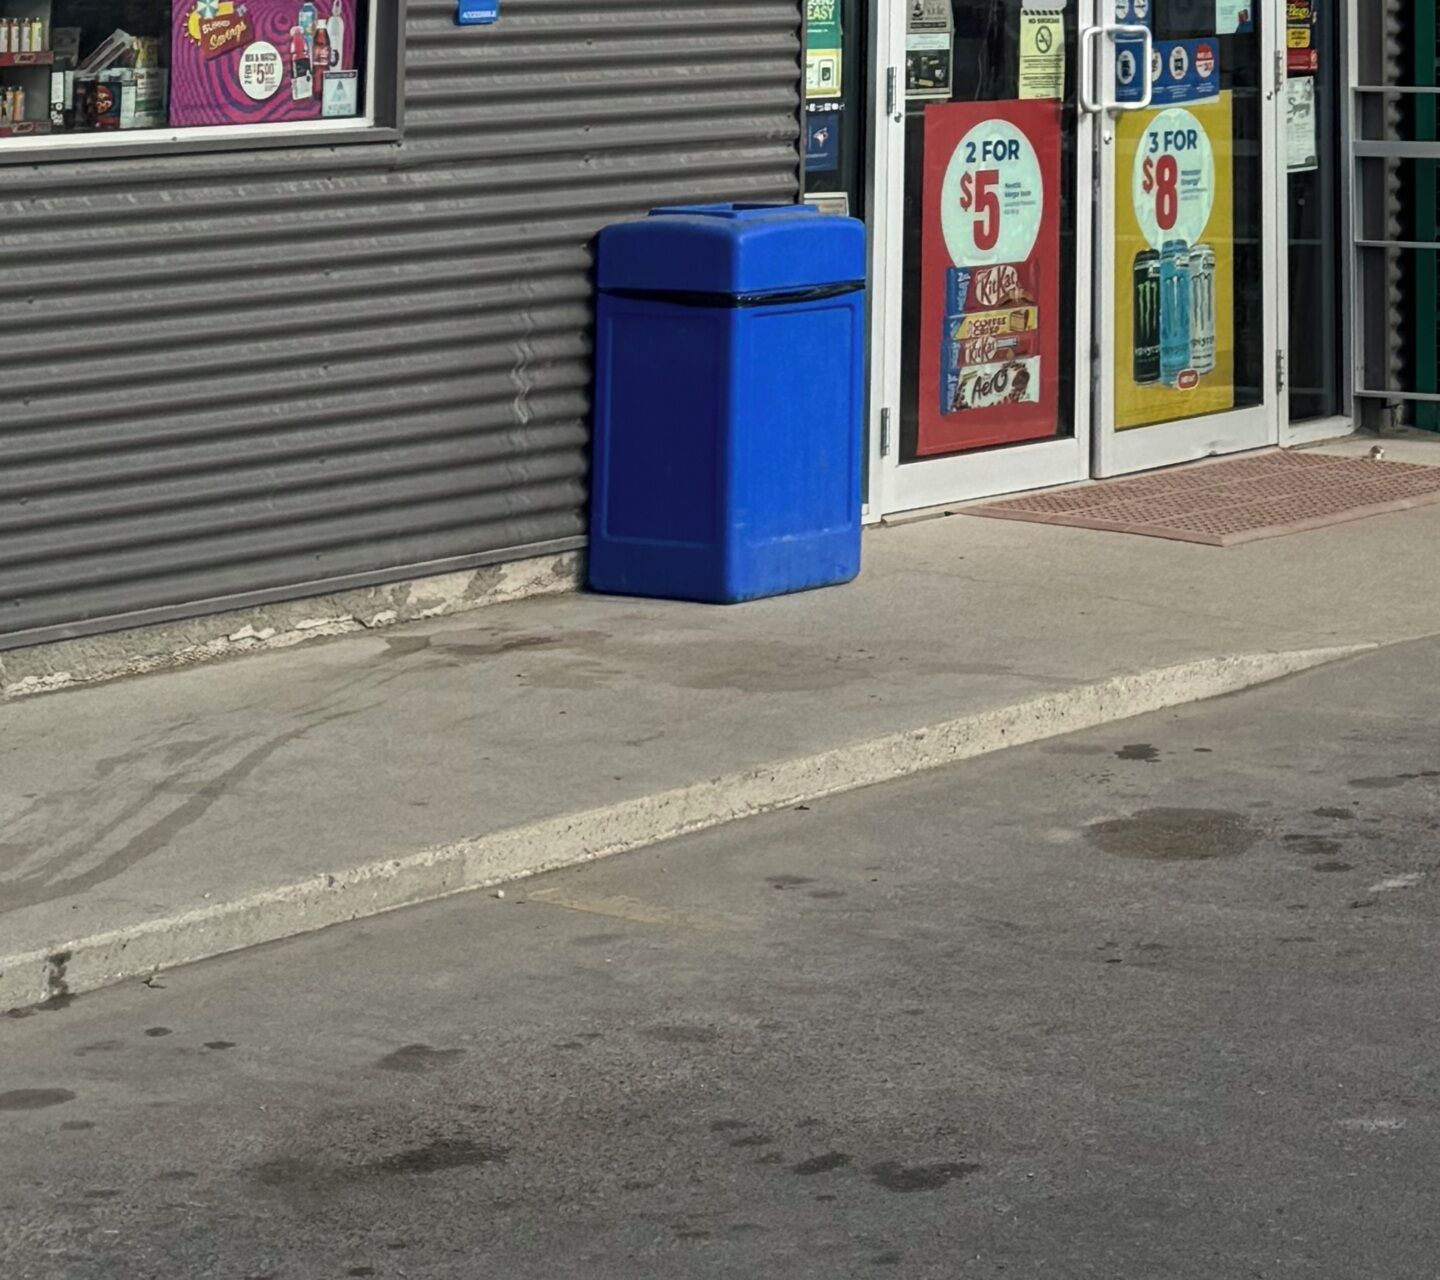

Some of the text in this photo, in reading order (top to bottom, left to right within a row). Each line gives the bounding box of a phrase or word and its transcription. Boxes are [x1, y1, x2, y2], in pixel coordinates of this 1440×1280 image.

[965, 139, 1020, 163] 2 FOR
[1149, 129, 1197, 153] 3 FOR
[980, 266, 1016, 306] KitKat
[974, 317, 1006, 328] COFFEE
